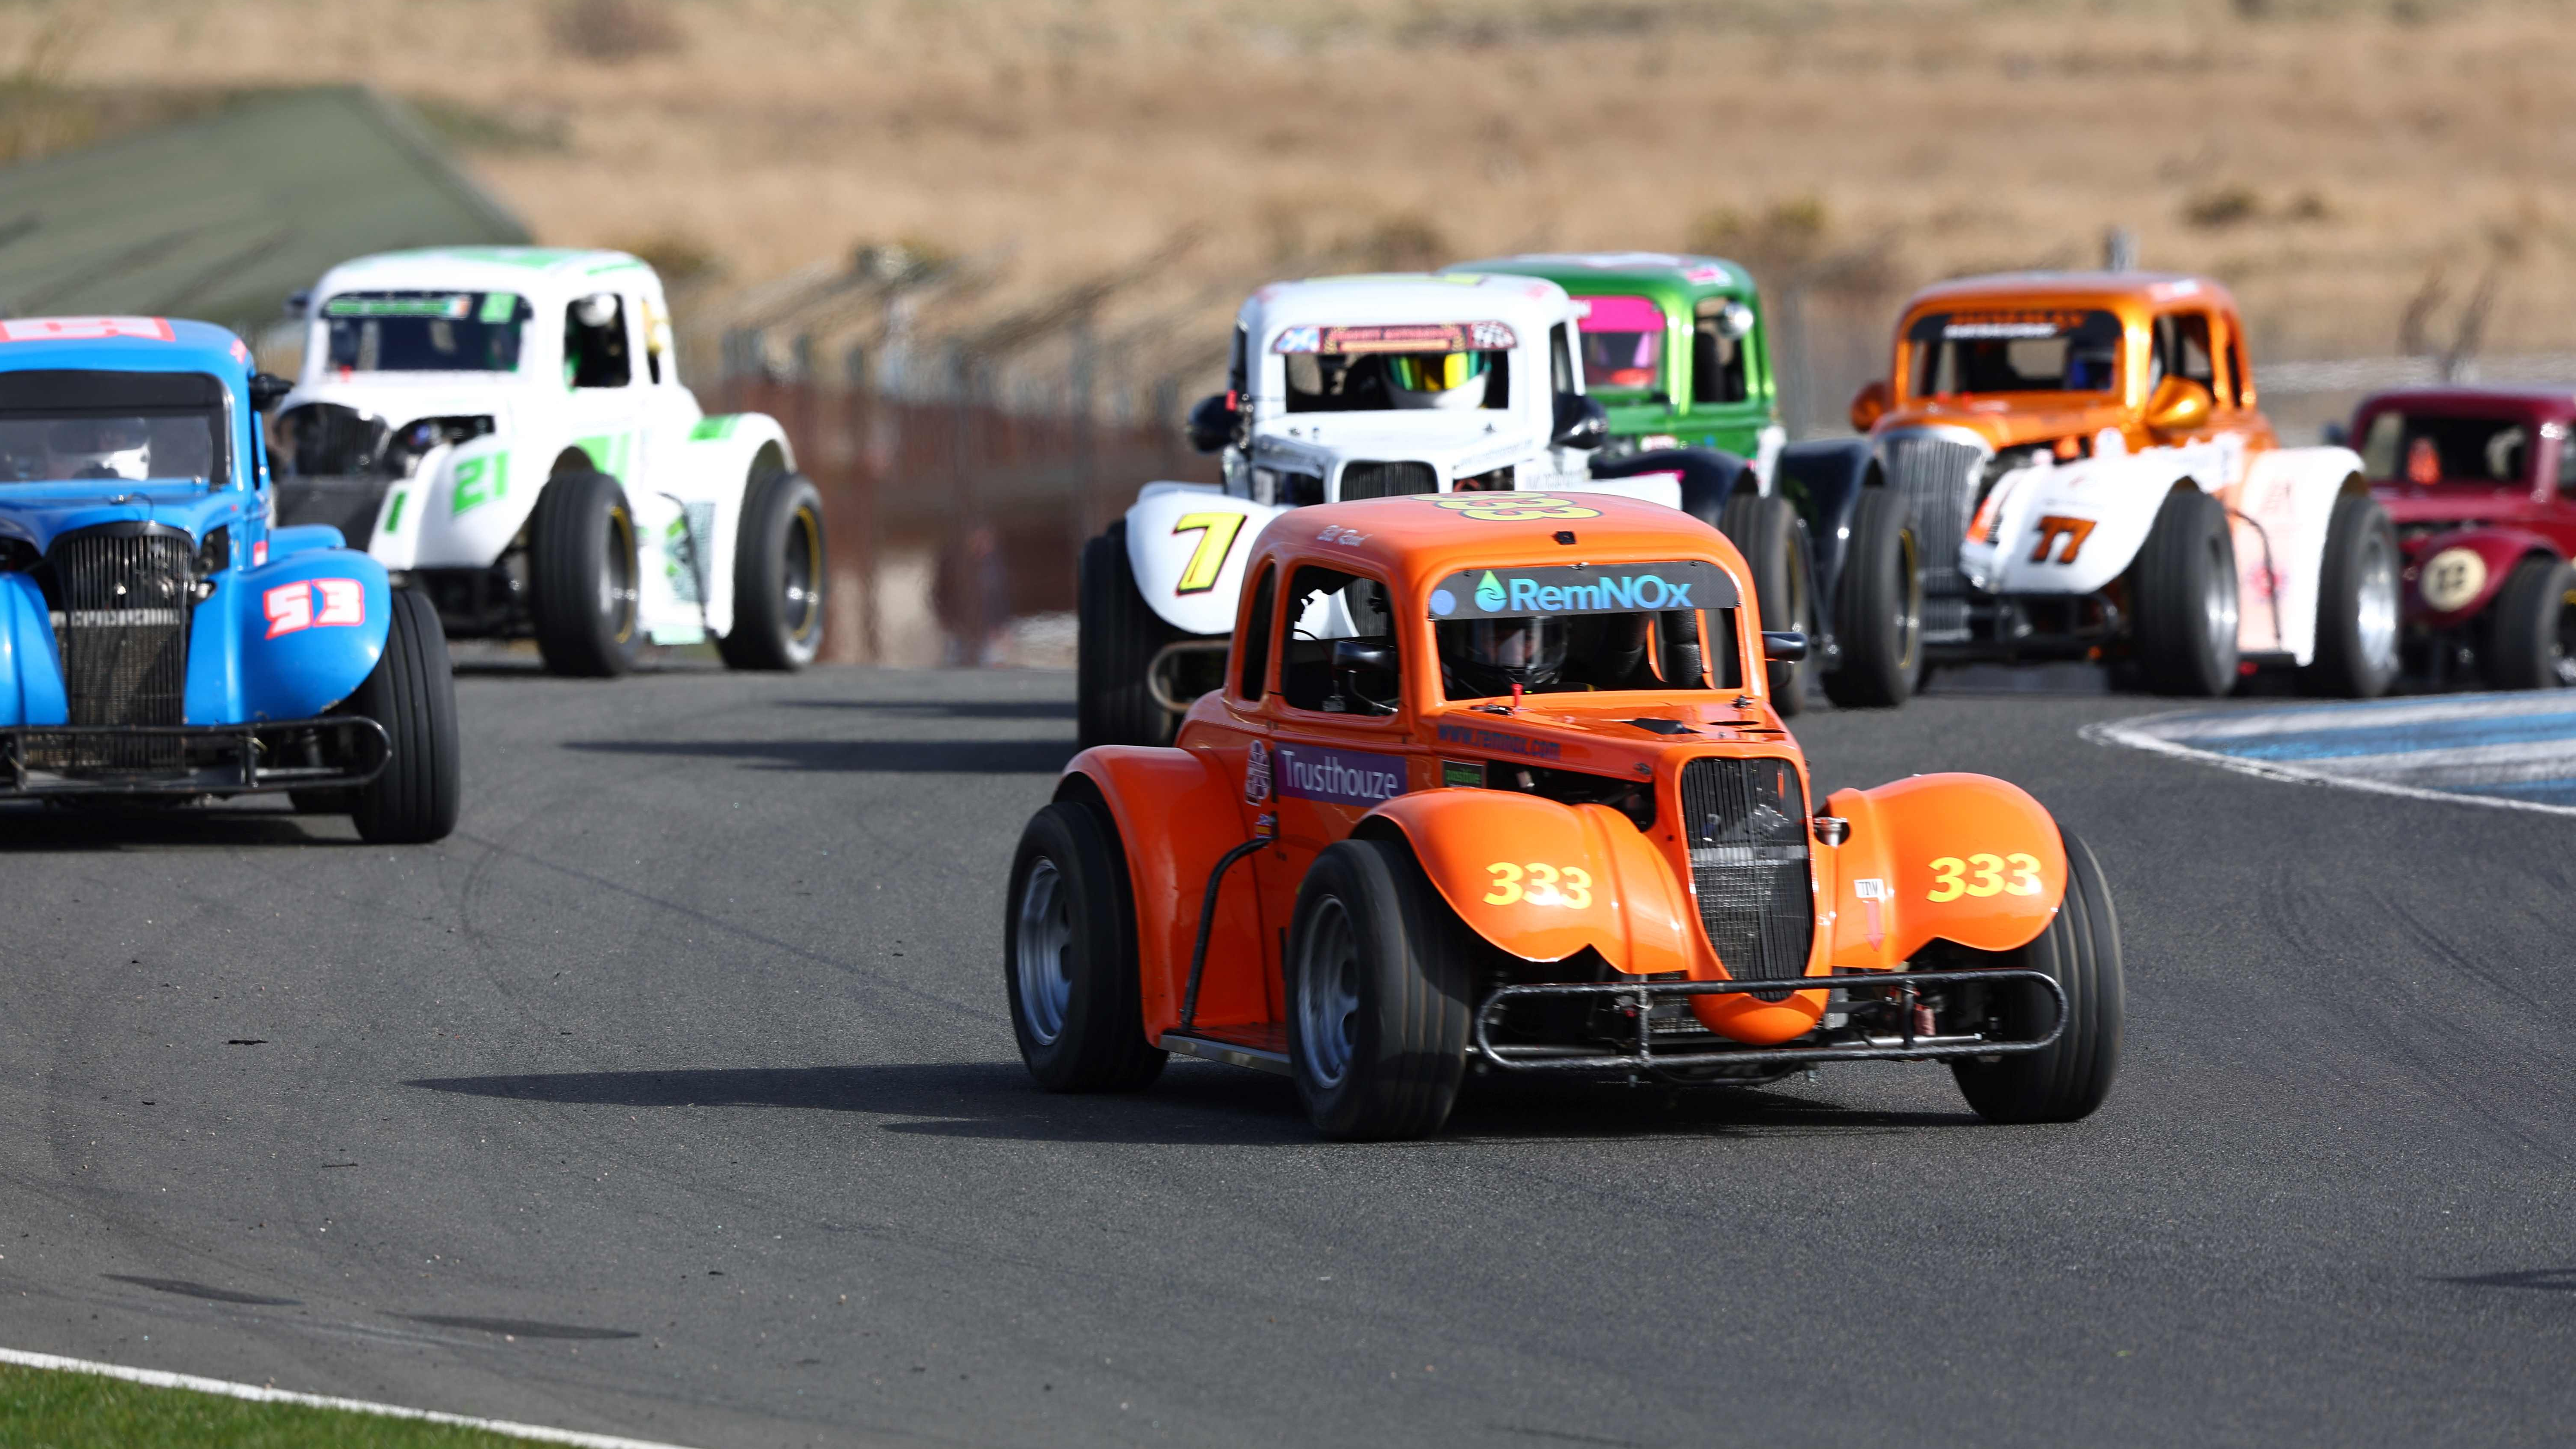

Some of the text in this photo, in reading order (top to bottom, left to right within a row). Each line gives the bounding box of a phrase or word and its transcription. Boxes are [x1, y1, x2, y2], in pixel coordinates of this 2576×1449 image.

[451, 450, 509, 515] 21
[1172, 512, 1247, 596] 7
[2030, 515, 2097, 564] 77
[263, 578, 365, 640] 53
[1509, 575, 1694, 612] RemNOx
[1281, 750, 1398, 800] Trusthouze
[1483, 862, 1593, 910] 333
[1926, 853, 2042, 903] 333
